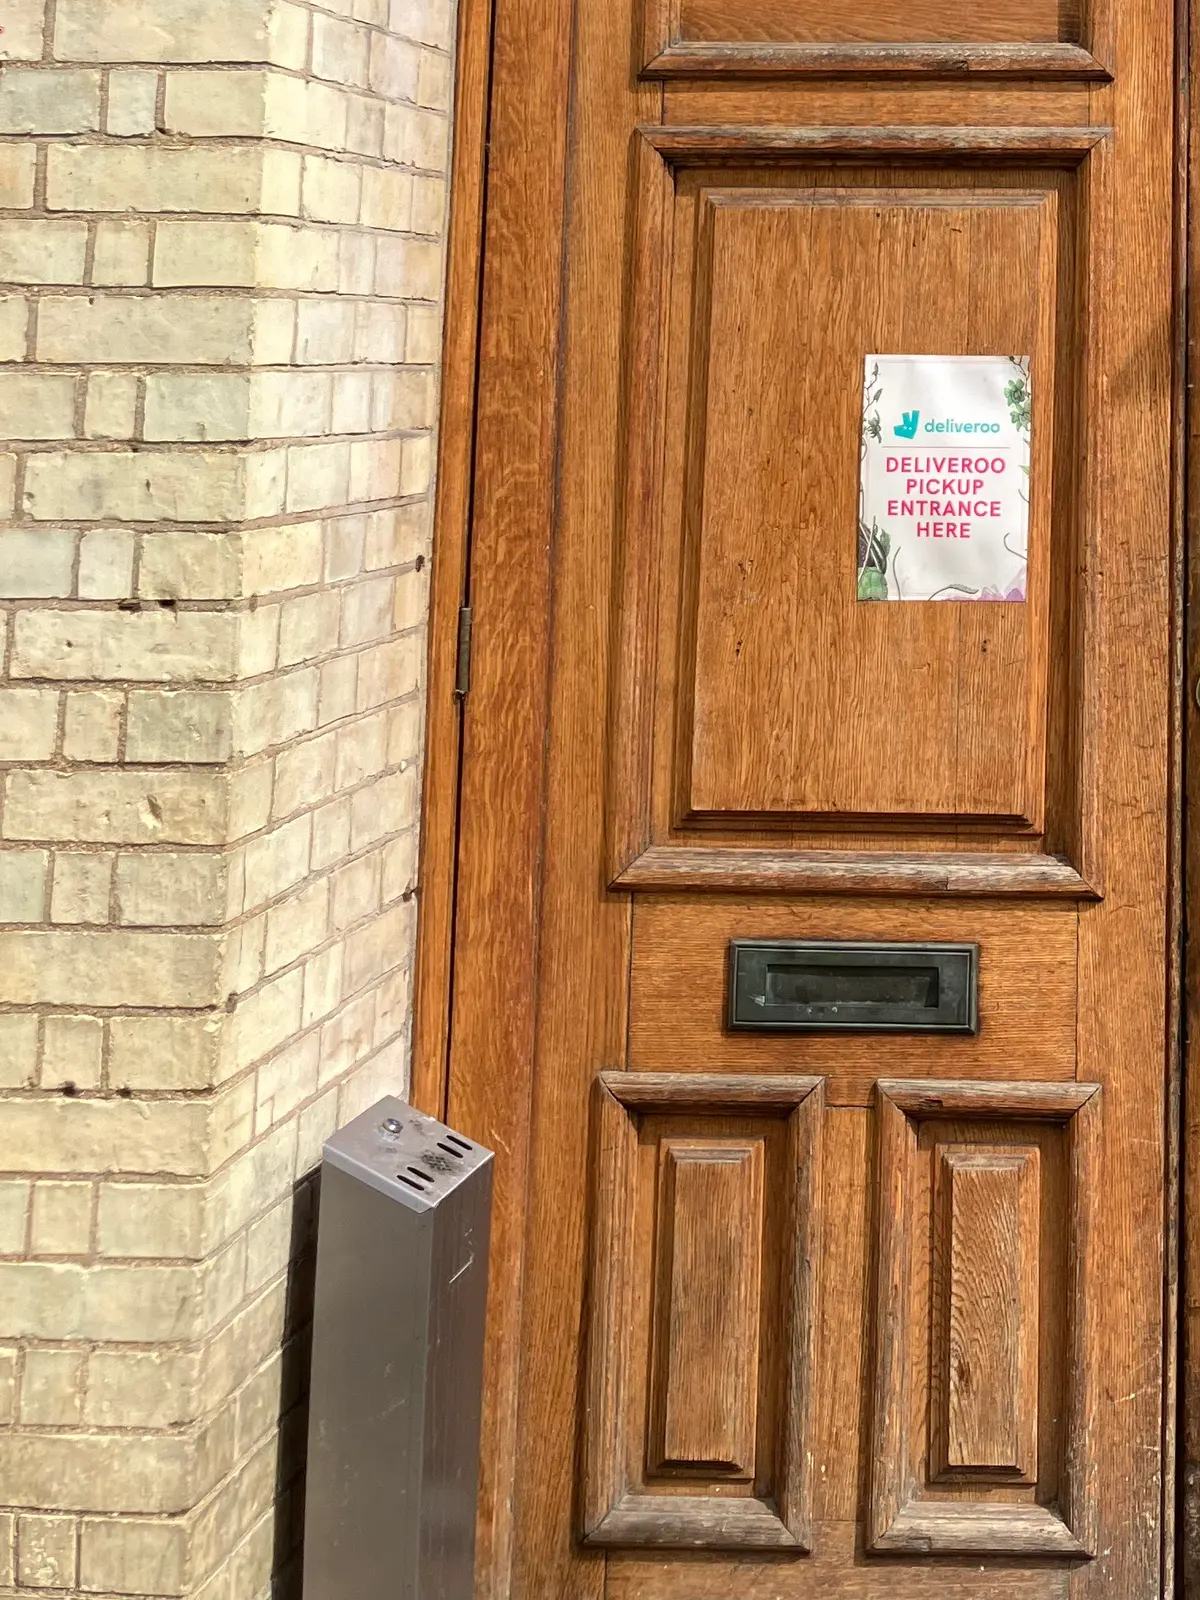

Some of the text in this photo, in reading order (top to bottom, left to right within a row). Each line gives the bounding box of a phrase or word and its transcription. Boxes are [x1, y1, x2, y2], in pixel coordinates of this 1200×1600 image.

[924, 418, 1001, 434] deliveroo
[885, 456, 1006, 474] DELIVEROO
[906, 478, 984, 495] PICKUP
[887, 500, 1002, 518] ENTRANCE
[916, 521, 972, 539] HERE
